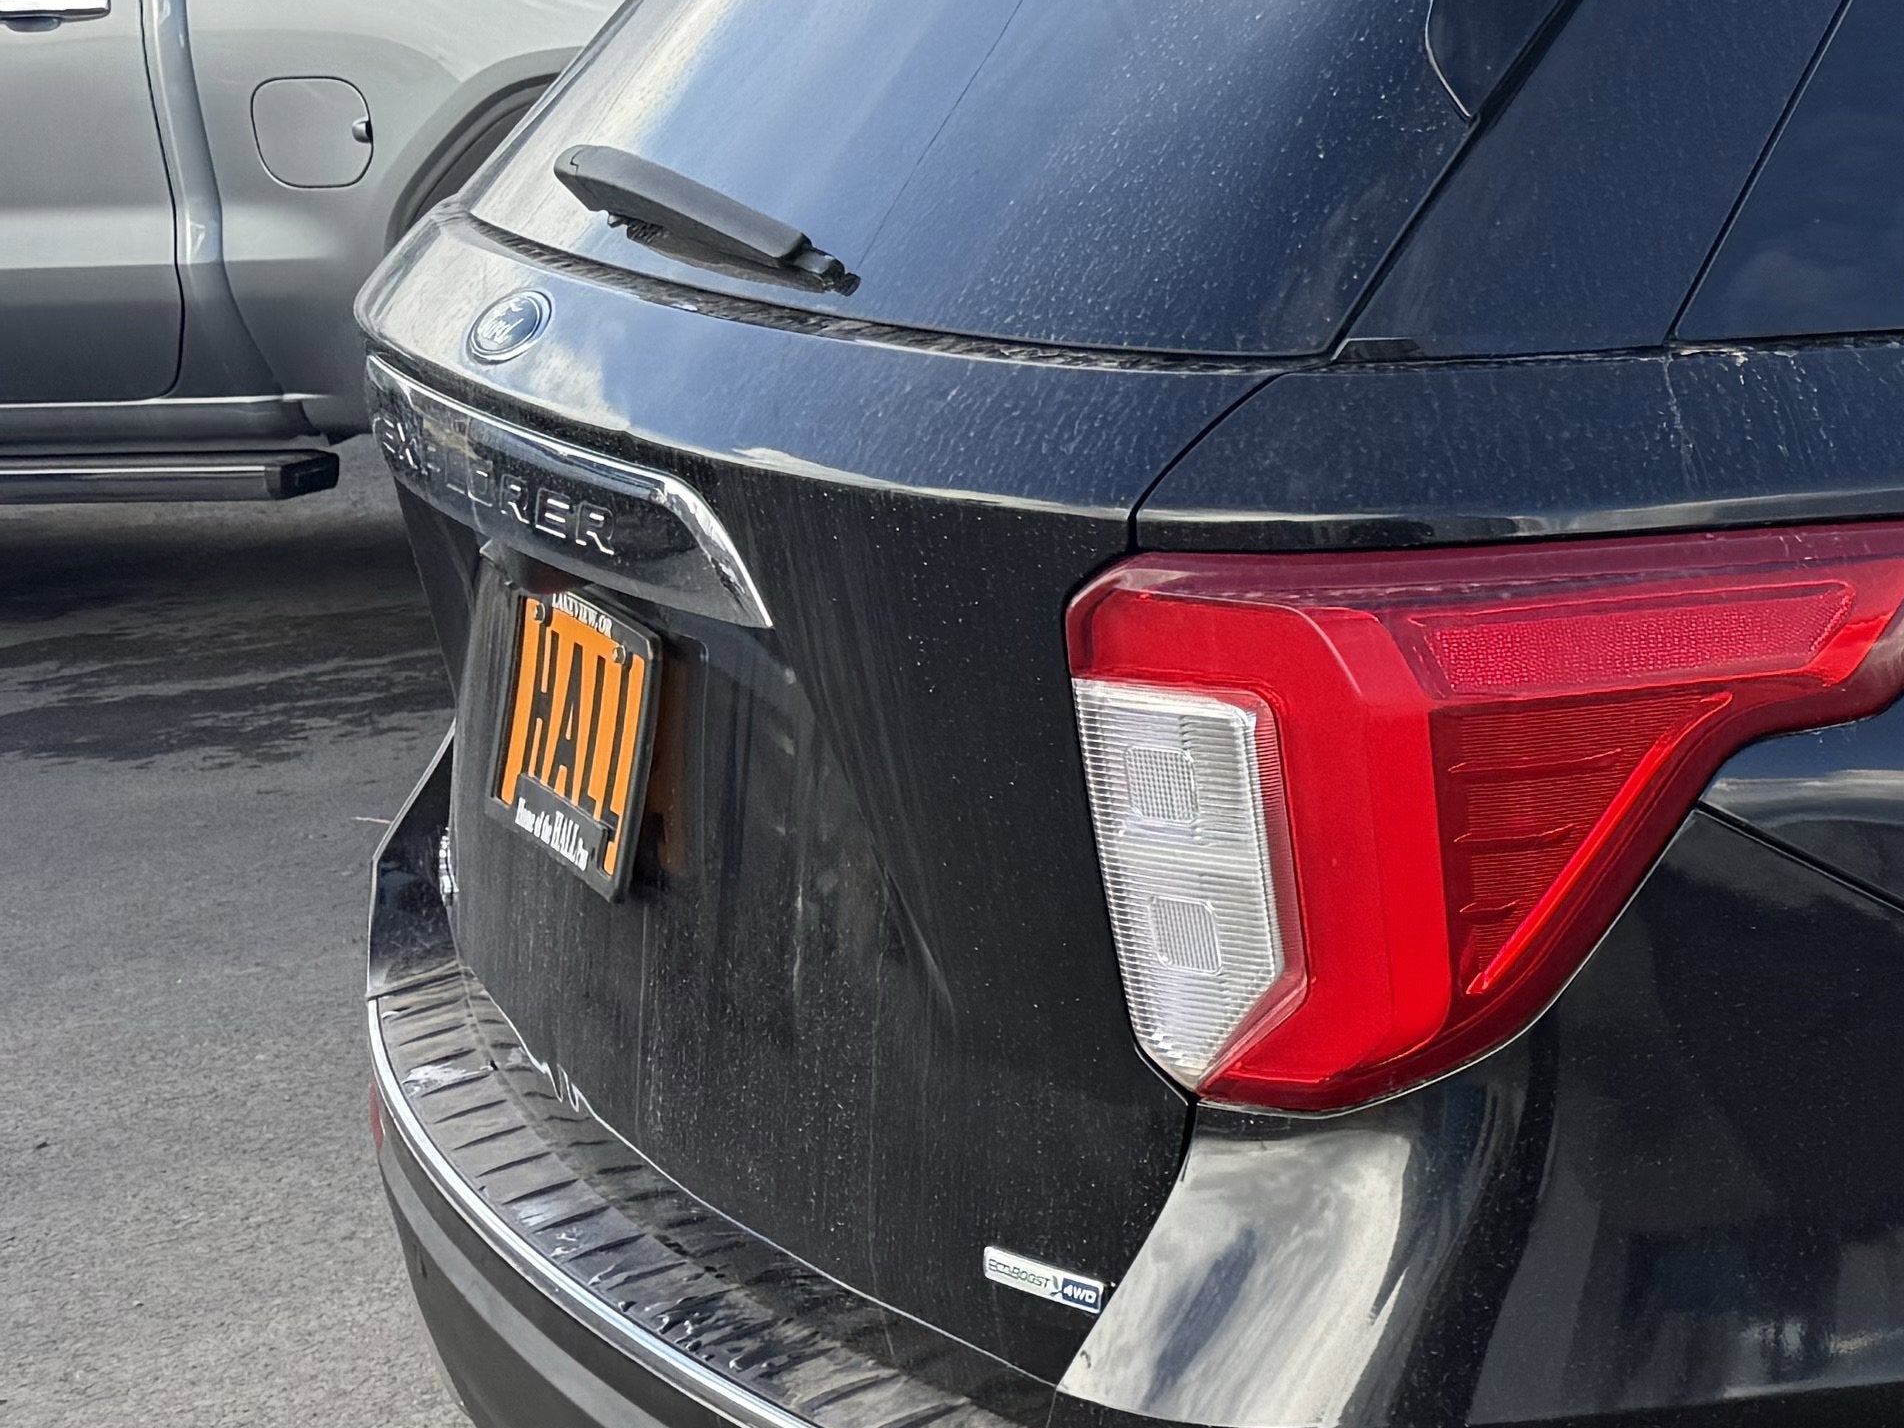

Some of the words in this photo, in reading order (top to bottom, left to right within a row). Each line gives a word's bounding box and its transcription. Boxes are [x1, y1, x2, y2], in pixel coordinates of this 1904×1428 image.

[521, 620, 629, 840] HALL
[550, 811, 580, 863] HALL
[1063, 1284, 1097, 1304] 4WD
